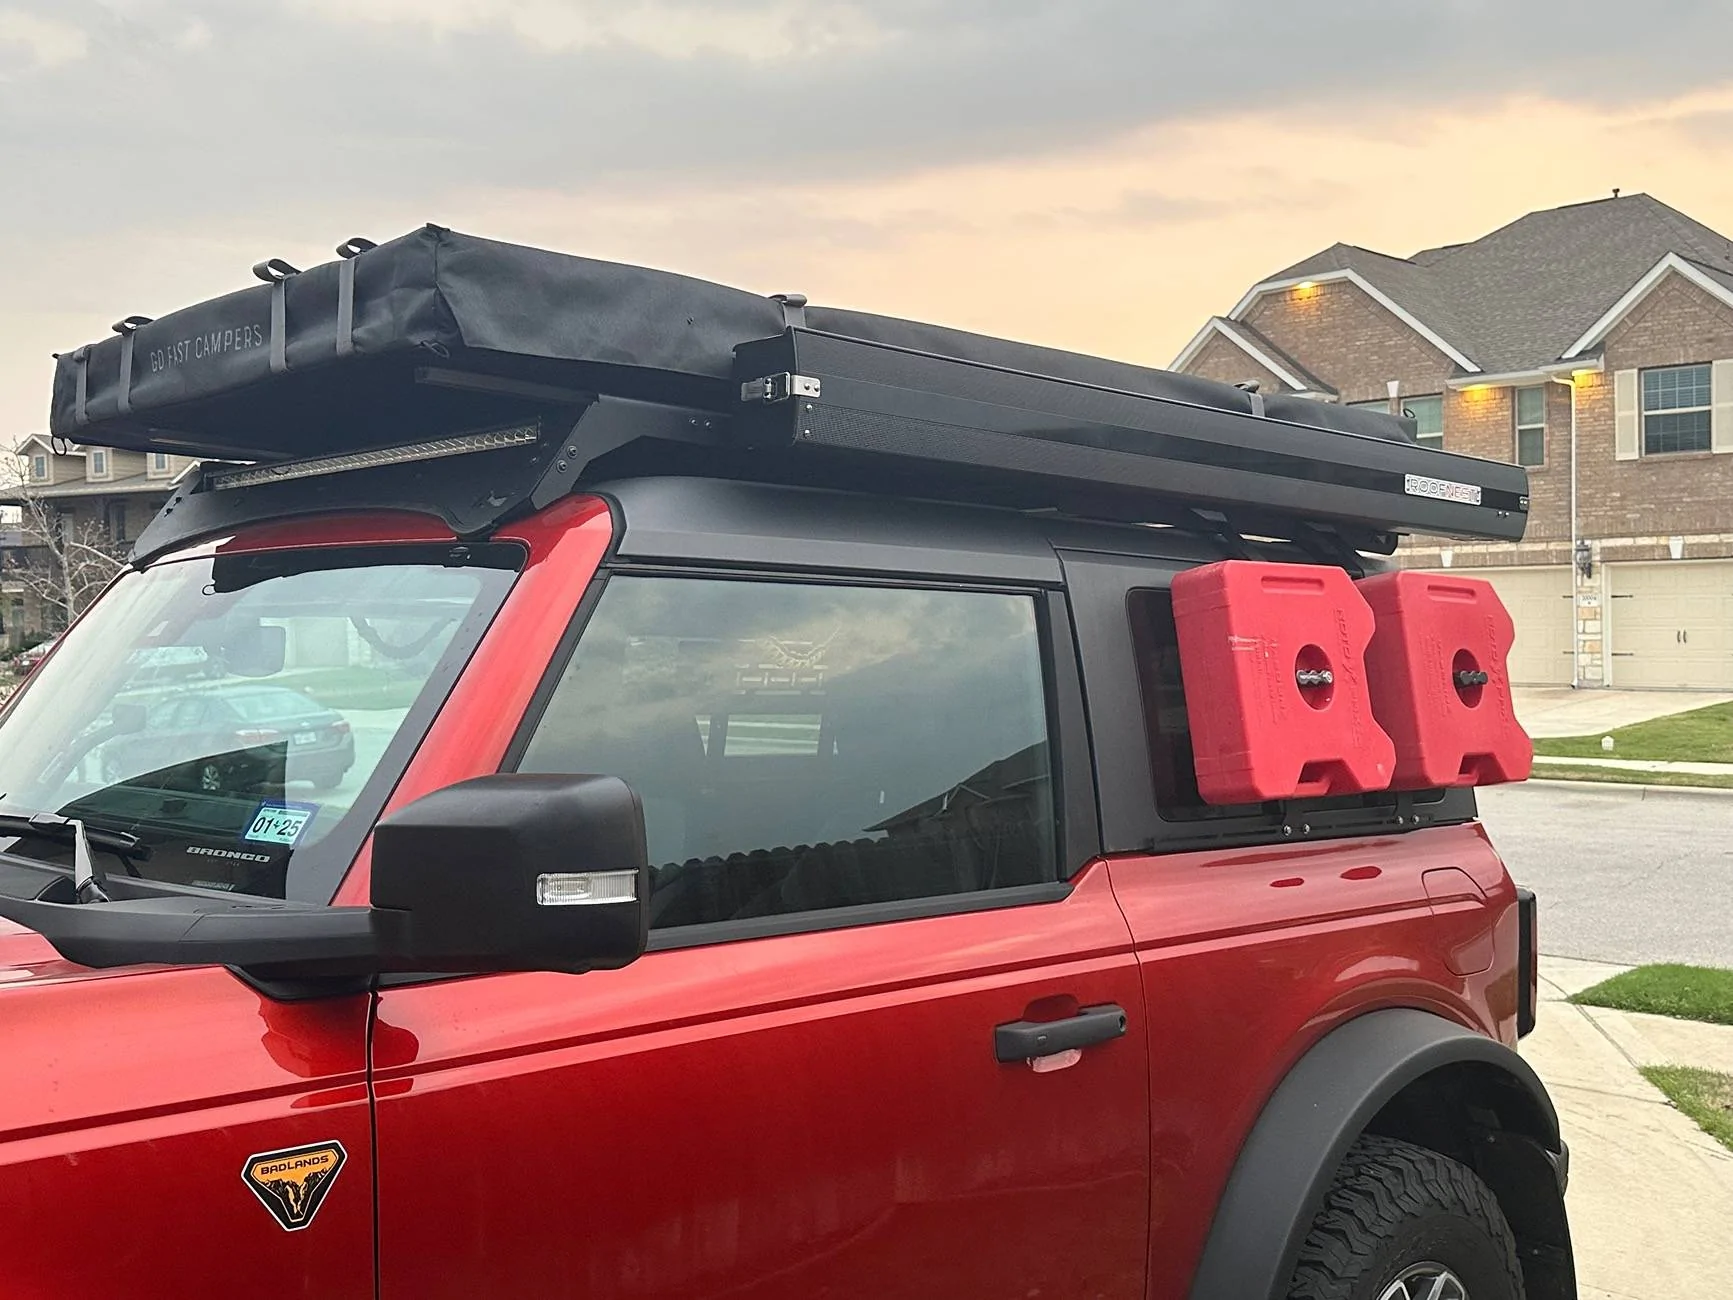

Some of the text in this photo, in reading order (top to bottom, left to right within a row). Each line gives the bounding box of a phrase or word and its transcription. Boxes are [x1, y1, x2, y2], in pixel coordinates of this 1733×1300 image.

[150, 324, 263, 372] GO FAST CAMPERS
[252, 816, 302, 837] 01 25
[186, 846, 271, 863] BRONCO
[261, 1155, 329, 1175] BADLANDS
